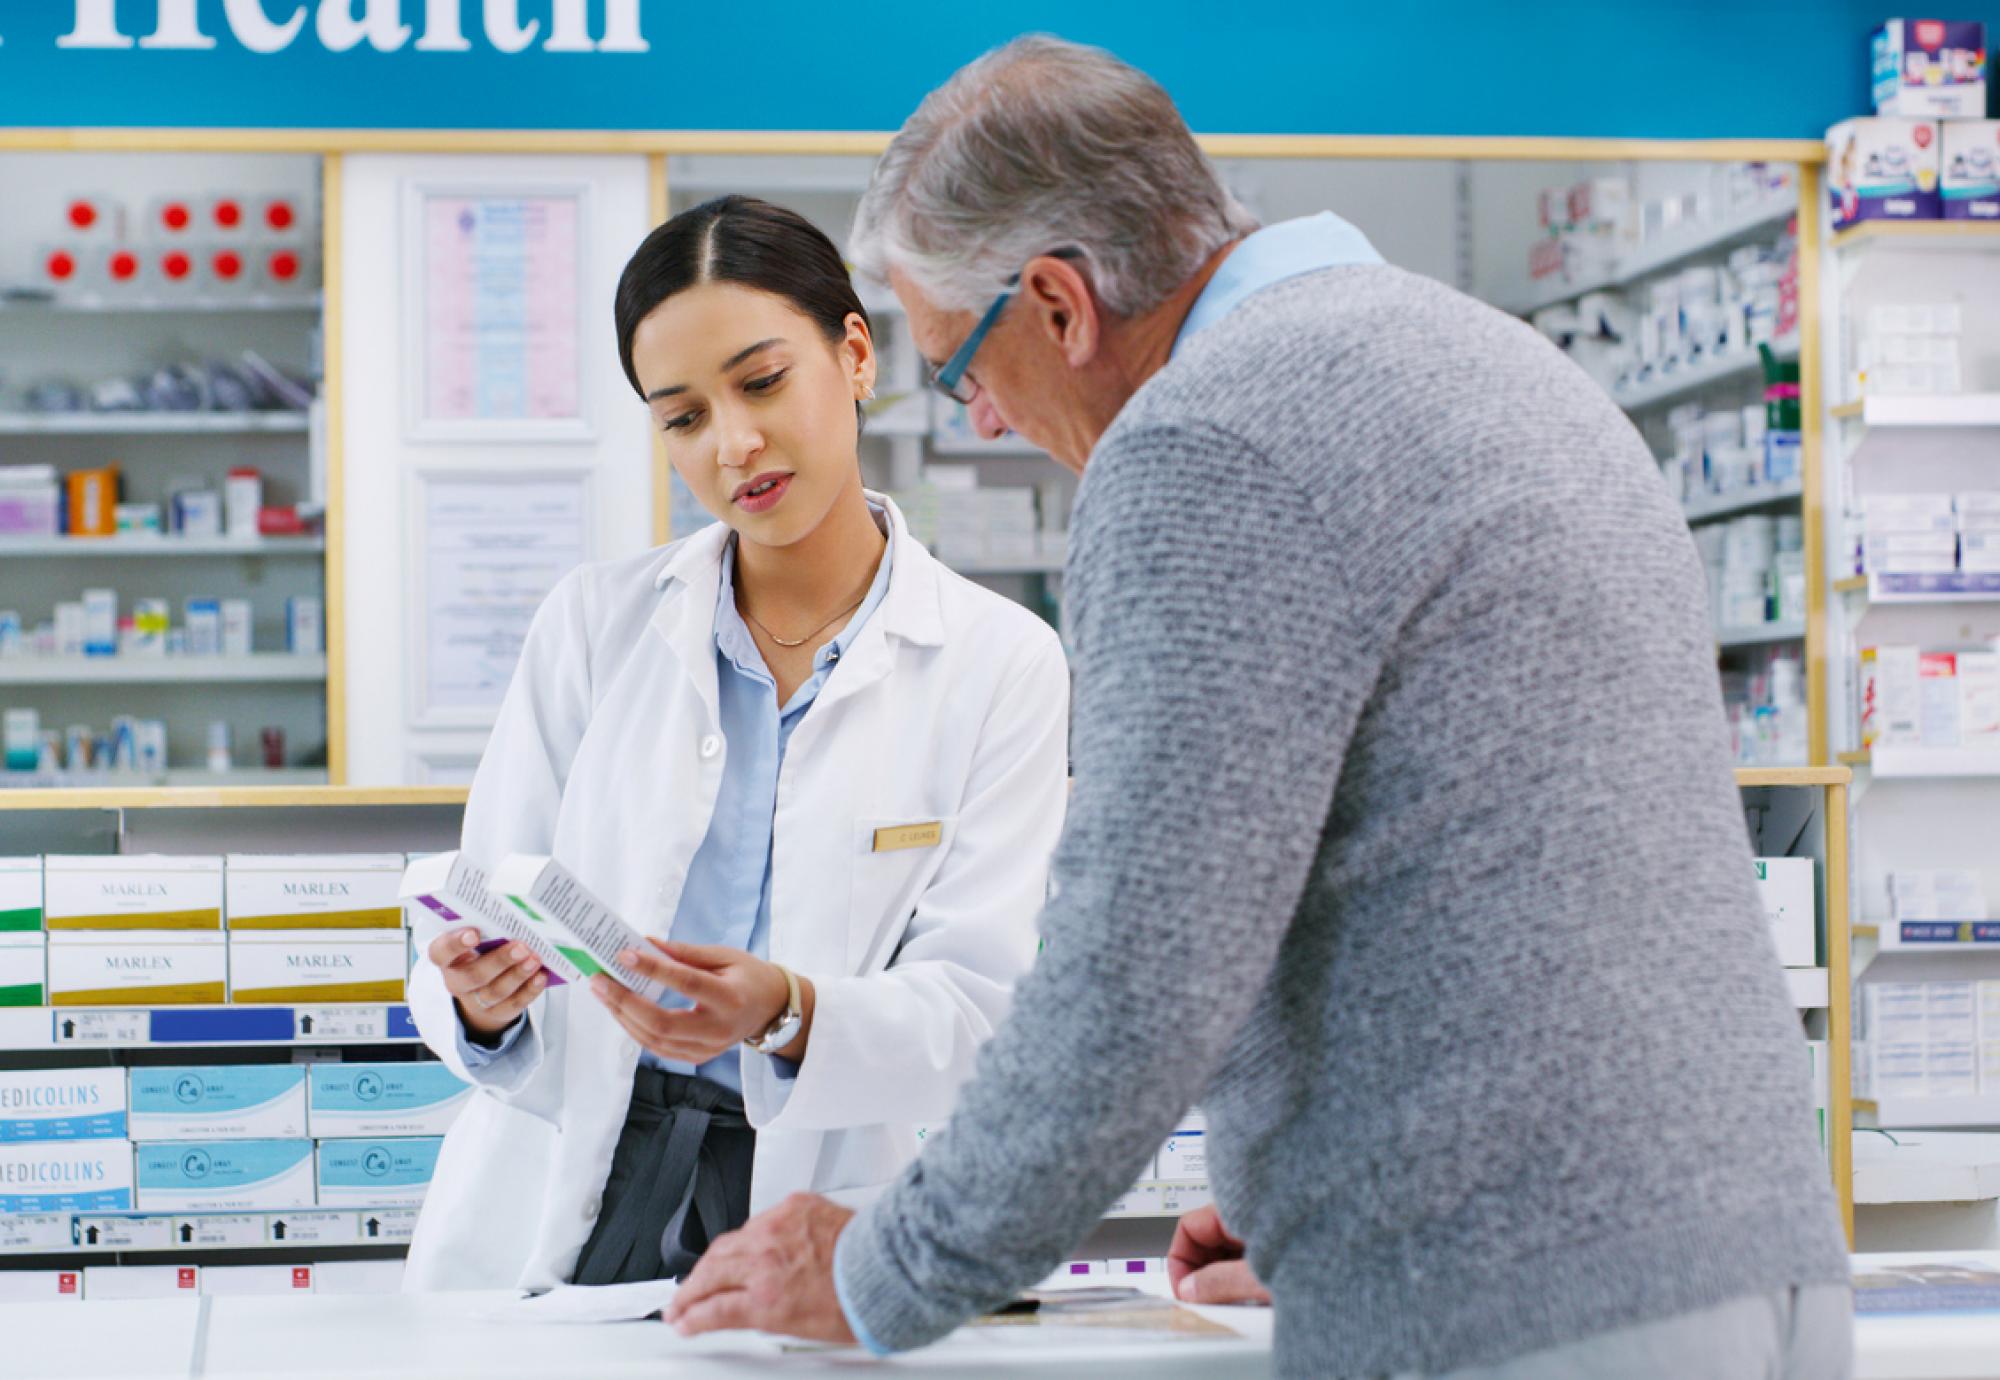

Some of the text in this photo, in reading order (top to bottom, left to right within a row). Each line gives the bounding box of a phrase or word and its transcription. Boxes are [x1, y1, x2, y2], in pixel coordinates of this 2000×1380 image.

[101, 883, 168, 897] MARLEX
[283, 882, 350, 896] MARLEX
[105, 956, 174, 969] MARLEX
[286, 954, 354, 968] MARLEX
[0, 1160, 105, 1182] EDICOLINS
